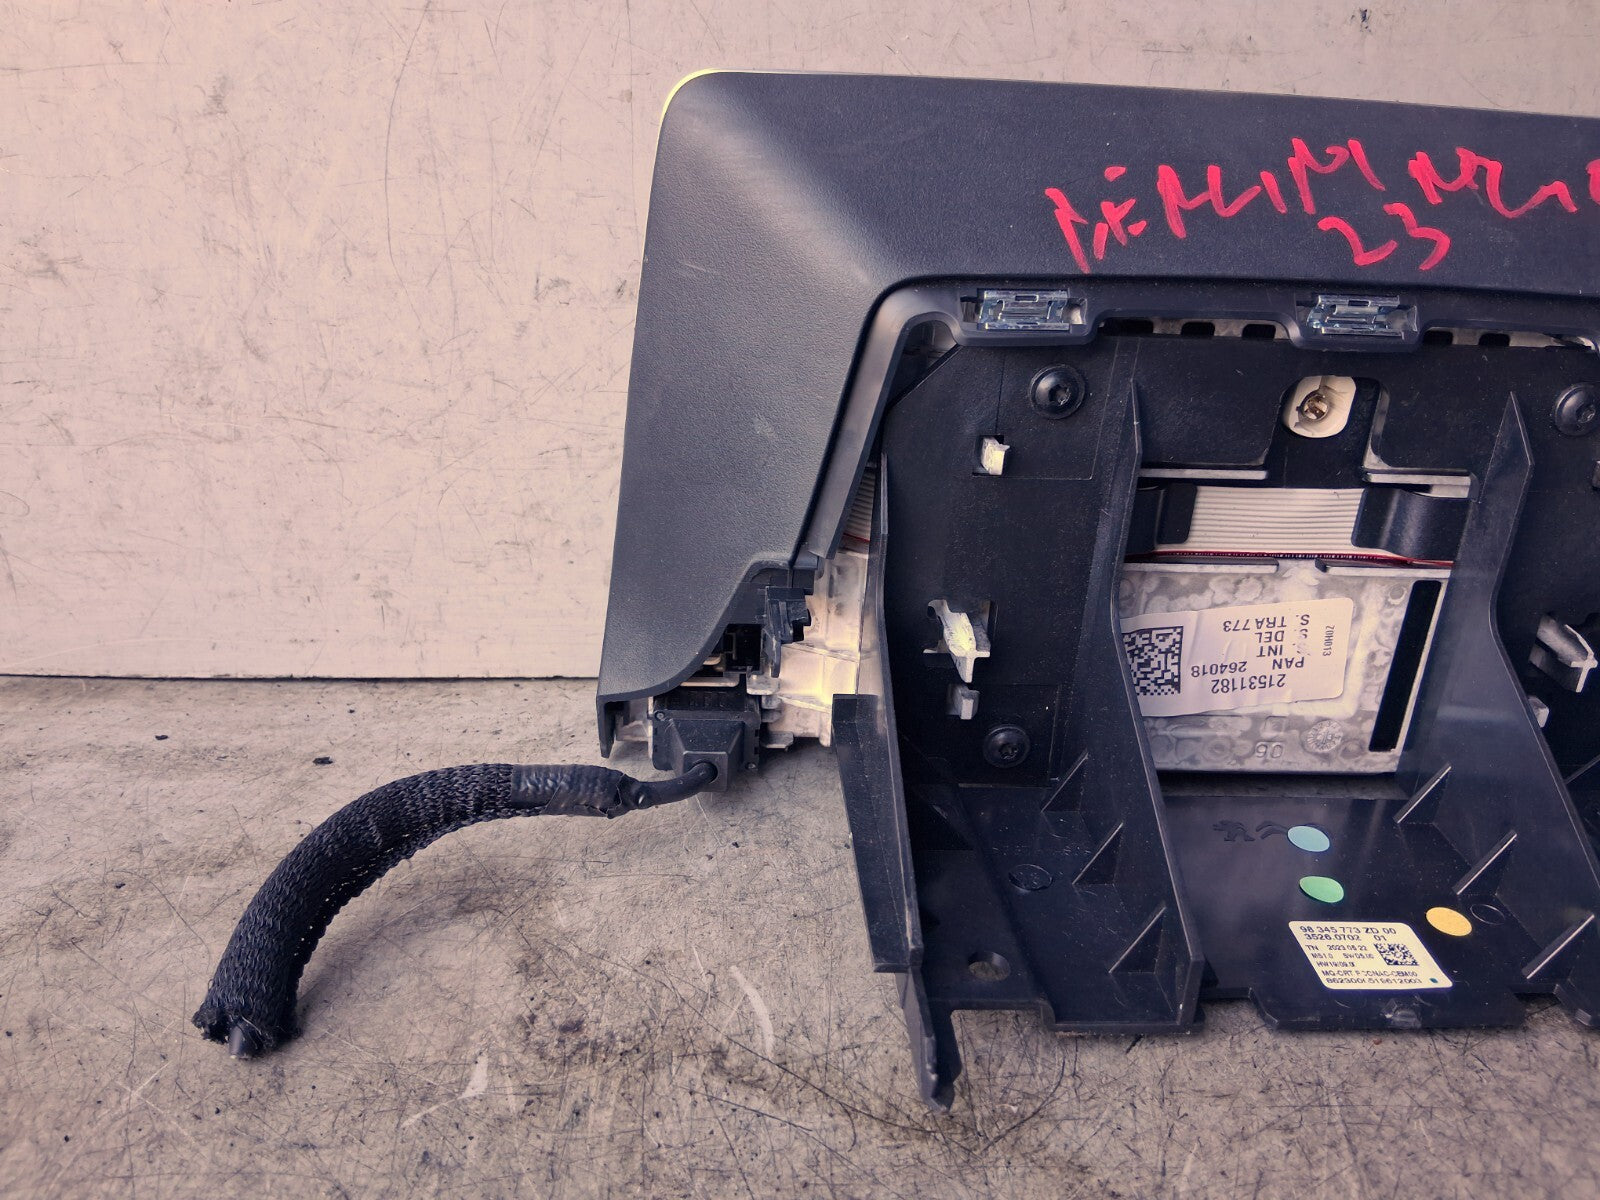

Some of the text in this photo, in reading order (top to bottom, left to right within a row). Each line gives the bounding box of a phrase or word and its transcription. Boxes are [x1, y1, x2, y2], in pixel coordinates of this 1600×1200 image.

[1223, 614, 1310, 632] S. TRA 773
[1255, 630, 1285, 643] DEL
[1256, 644, 1283, 657] INT
[1191, 656, 1305, 678] PAN 264018
[1211, 673, 1287, 694] 21531182
[1300, 925, 1314, 933] 98
[1339, 926, 1361, 934] 773
[1382, 927, 1397, 935] 00
